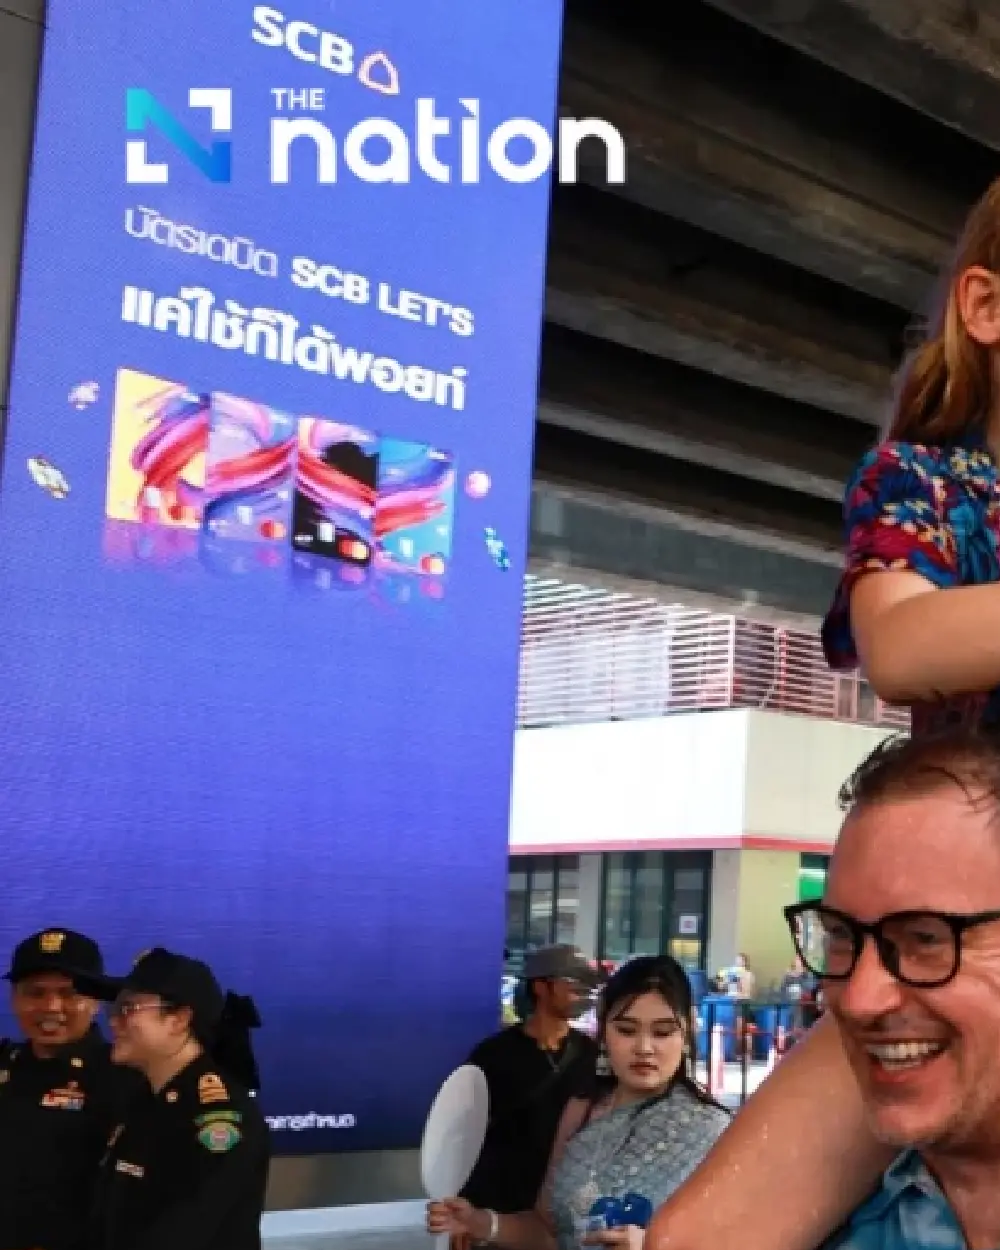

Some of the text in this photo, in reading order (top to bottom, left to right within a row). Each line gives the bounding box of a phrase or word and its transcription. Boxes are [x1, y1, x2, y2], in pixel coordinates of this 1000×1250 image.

[251, 5, 355, 76] SCB
[290, 256, 370, 305] SCB
[378, 281, 475, 337] LET'S
